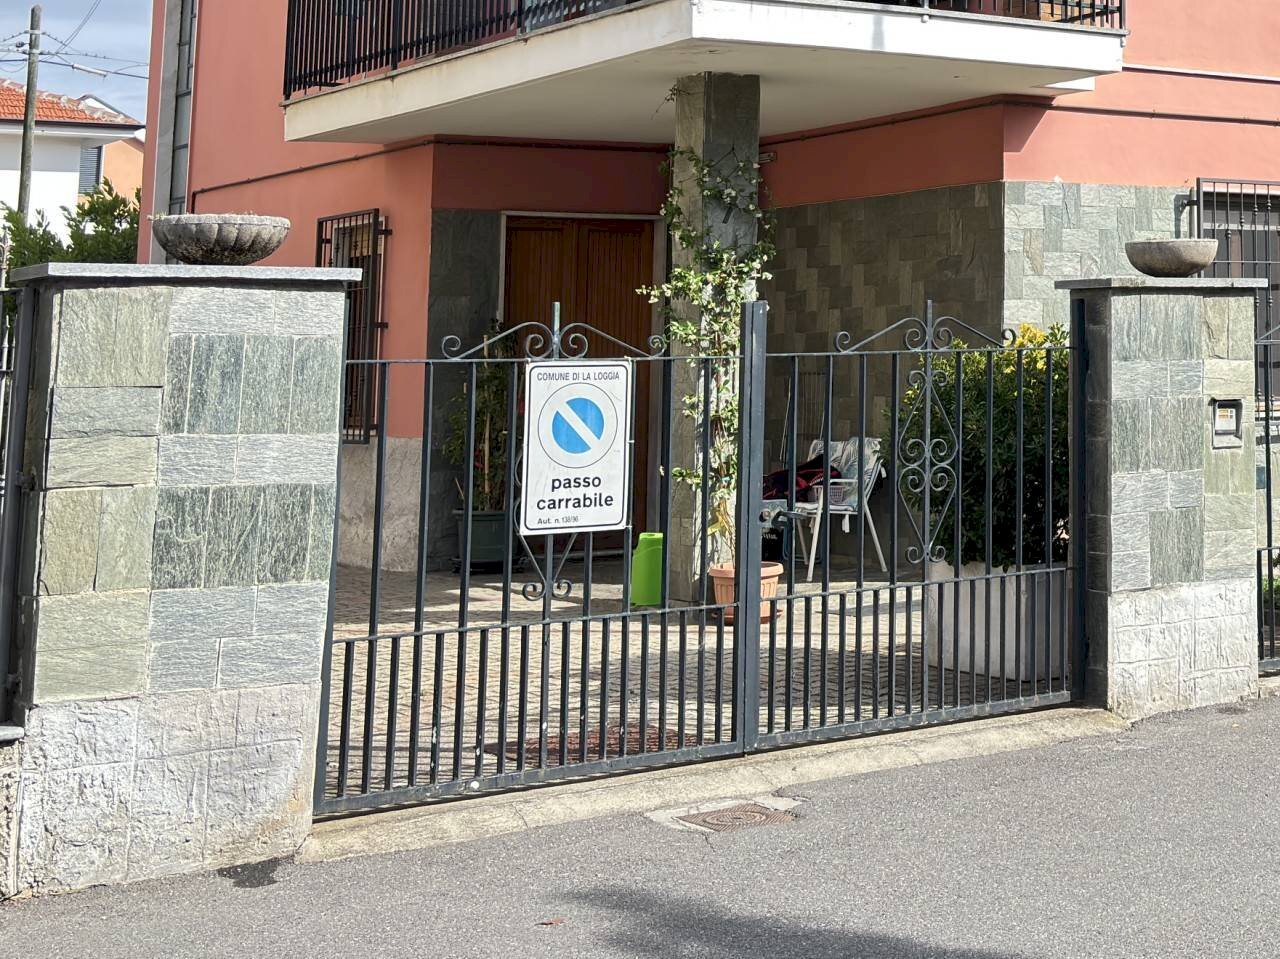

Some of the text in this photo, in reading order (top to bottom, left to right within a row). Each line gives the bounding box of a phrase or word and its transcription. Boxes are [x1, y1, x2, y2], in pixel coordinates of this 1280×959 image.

[537, 371, 620, 381] COMUNE DI LA LOGGIA
[551, 476, 602, 492] passo
[536, 492, 614, 510] carrabile
